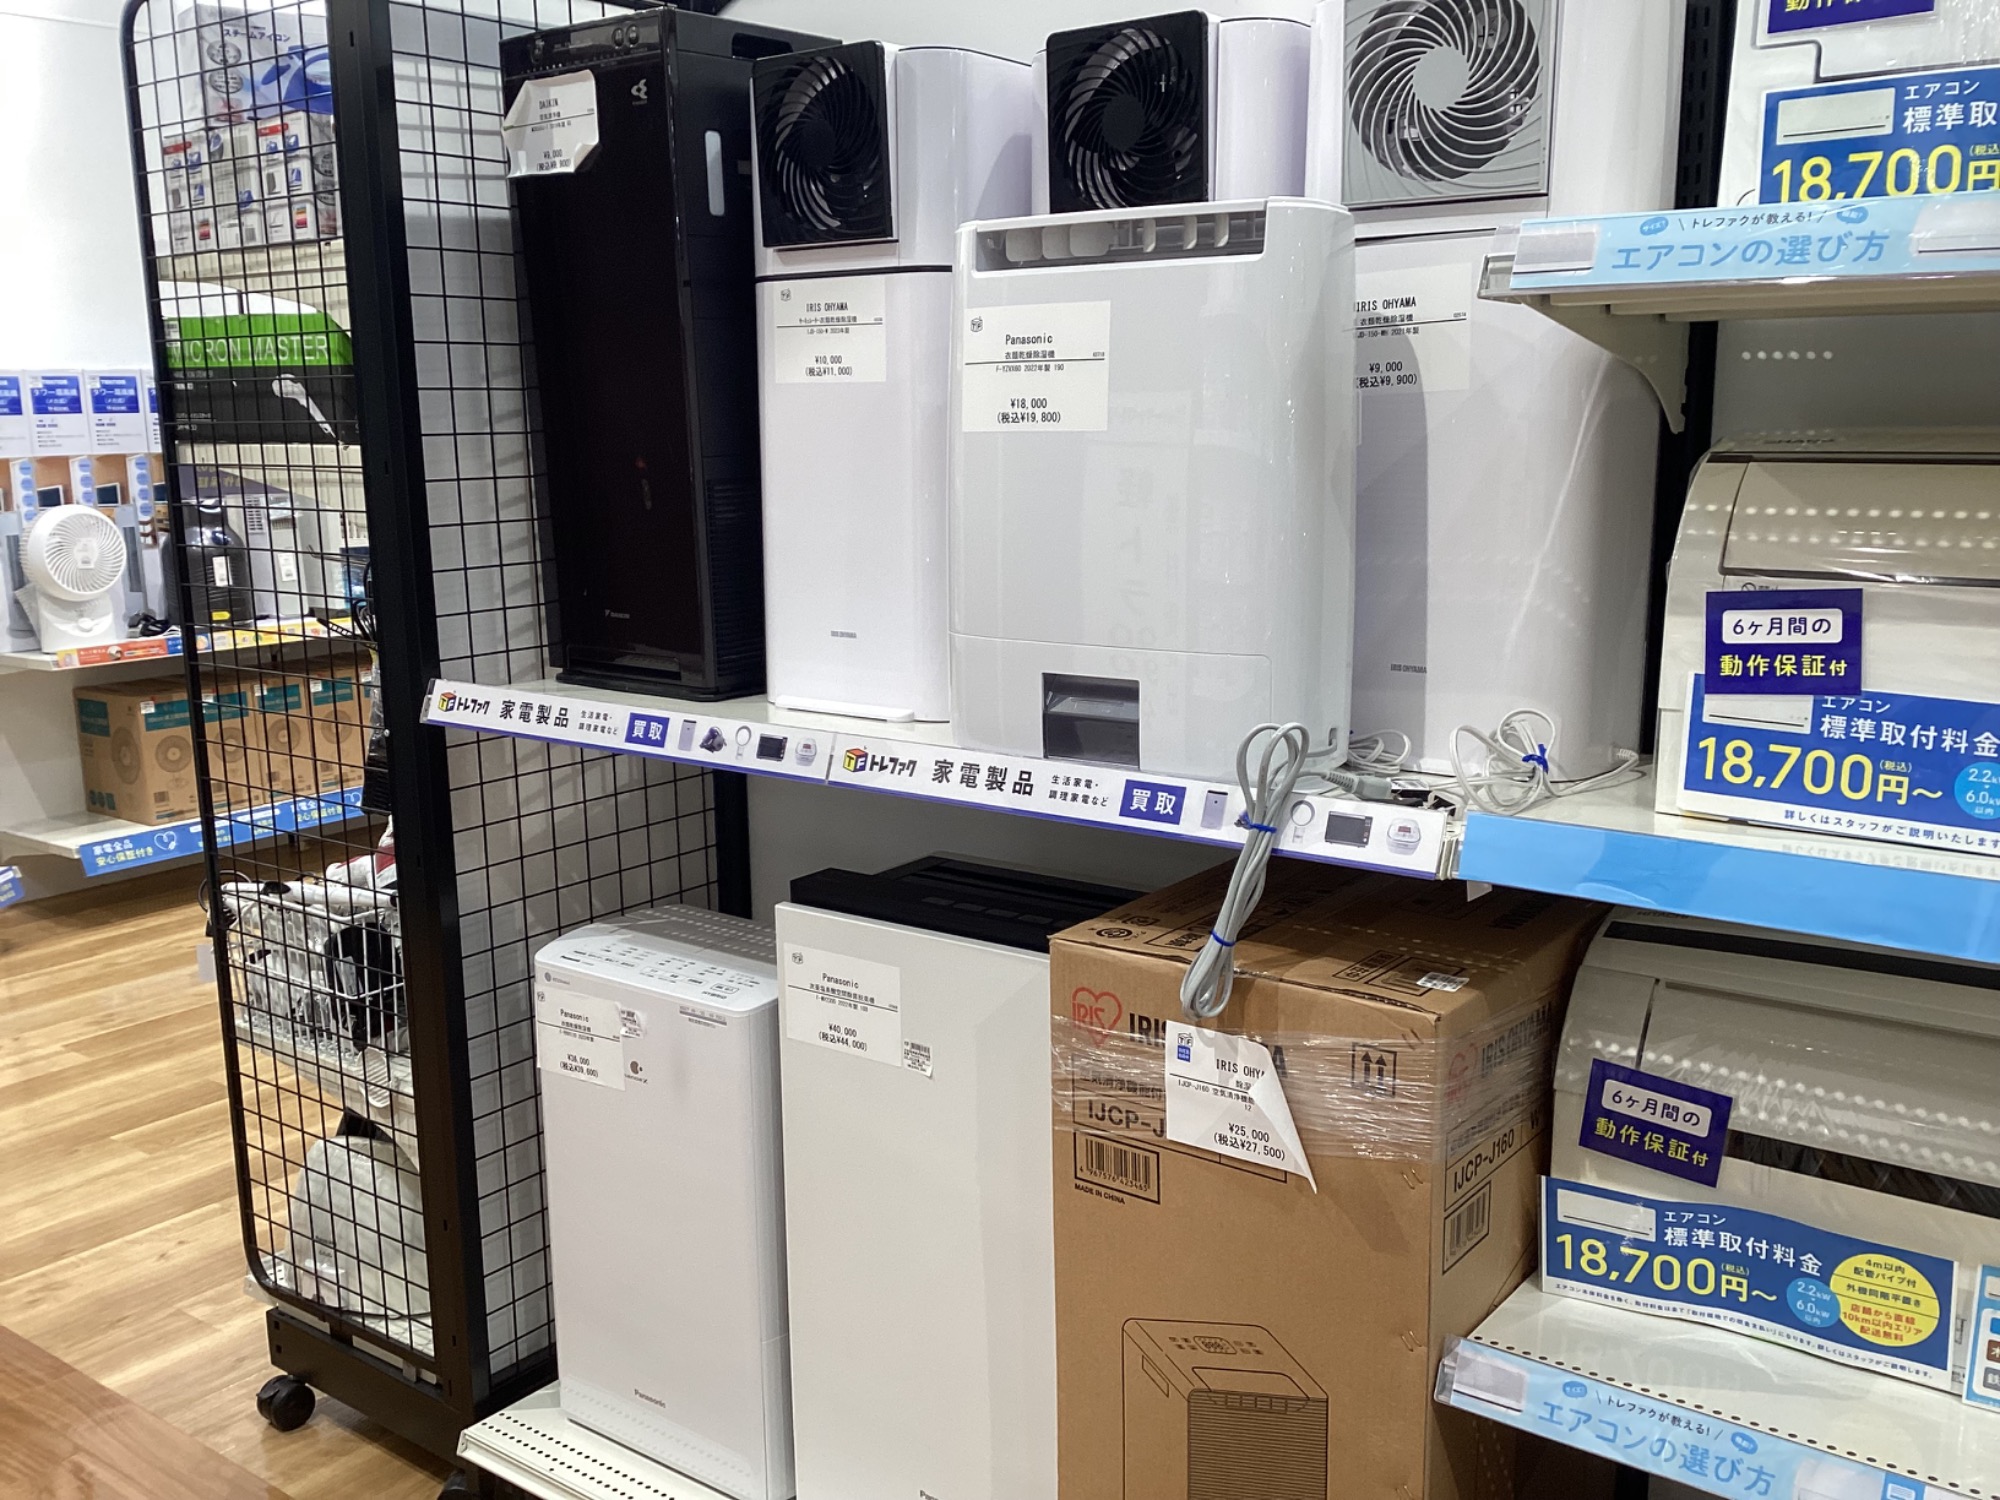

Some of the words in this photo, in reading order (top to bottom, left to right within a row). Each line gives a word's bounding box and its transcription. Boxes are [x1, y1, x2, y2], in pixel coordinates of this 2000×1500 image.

[1904, 79, 1981, 100] エアコン
[1903, 101, 1998, 134] 標準取
[1611, 230, 1890, 271] エアコンの選び方
[806, 302, 822, 313] IRIS
[824, 301, 849, 312] OHYAMA
[1356, 299, 1377, 312] IRIS
[1382, 296, 1416, 310] OHYAMA
[172, 337, 241, 363] MICRON
[248, 335, 329, 362] MASTER
[1005, 333, 1053, 345] Panasonic
[814, 355, 843, 365] ¥10,000
[1024, 363, 1050, 372] 2022年製
[1369, 361, 1403, 374] ¥9,000
[805, 366, 853, 377] (税込¥11,000)
[1010, 398, 1048, 409] ¥18,000
[997, 411, 1061, 424] (税込¥19,800)
[1719, 654, 1848, 678] 動作保証付
[456, 696, 491, 716] トレファク
[499, 699, 570, 729] 家電製品
[1822, 694, 1891, 715] エアコン
[631, 719, 662, 741] 買取
[1820, 713, 2000, 758] 標準取付料金
[868, 754, 918, 778] トレファク
[932, 758, 1035, 797] 家電製品
[1879, 759, 1913, 773] (税込)
[1048, 788, 1110, 808] 調理家電など
[1129, 787, 1177, 816] 買取
[96, 846, 154, 868] 安心保証付き
[822, 972, 860, 989] Panasonic
[560, 1008, 590, 1023] Panasonic
[1072, 1002, 1105, 1031] IRIS
[828, 1022, 858, 1038] ¥40,000
[1129, 1012, 1166, 1048] IRI
[818, 1031, 868, 1052] (税込¥44,000)
[1216, 1058, 1239, 1074] IRIS
[1228, 1122, 1270, 1143] ¥25,000
[1593, 1116, 1709, 1168] 動作保証付
[1213, 1132, 1286, 1162] (税込¥27,500)
[1453, 1128, 1516, 1194] IJCP-J160
[1074, 1182, 1095, 1195] MADE
[1094, 1188, 1103, 1198] IN
[1103, 1191, 1126, 1205] CHINA
[1664, 1210, 1727, 1226] エアコン
[1664, 1226, 1823, 1278] 標準取付料金
[1720, 1262, 1750, 1277] (税込)
[1853, 1265, 1917, 1289] 配管パイプ付
[1865, 1258, 1906, 1275] 4m以内
[1842, 1311, 1923, 1336] 10km以内エリア
[1537, 1400, 1777, 1498] エアコンの選び方
